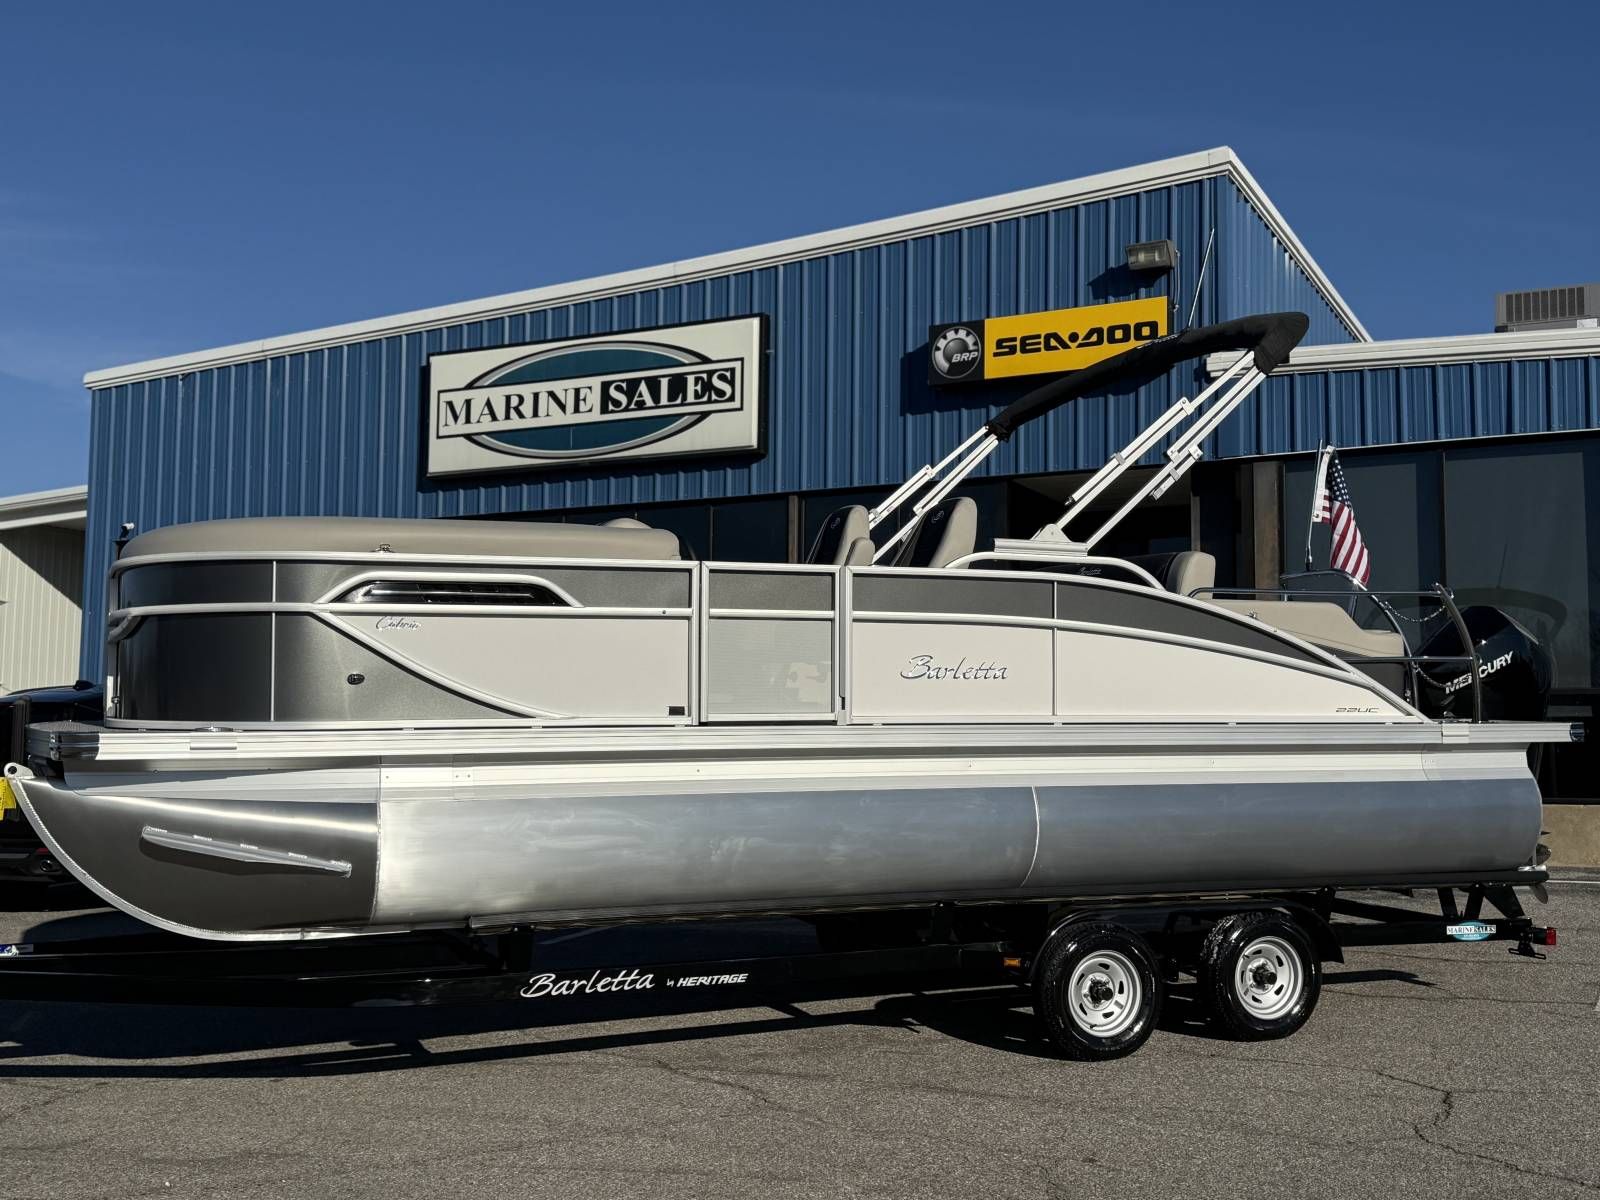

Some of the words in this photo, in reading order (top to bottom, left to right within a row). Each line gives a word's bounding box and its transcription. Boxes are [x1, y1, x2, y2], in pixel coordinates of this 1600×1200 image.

[951, 351, 978, 363] BRP
[442, 386, 593, 427] MARINE
[608, 369, 733, 412] SALES
[900, 654, 1008, 680] Barletta
[1445, 651, 1514, 694] MECURY
[520, 969, 655, 998] Barletta
[676, 973, 749, 987] HERITAGE
